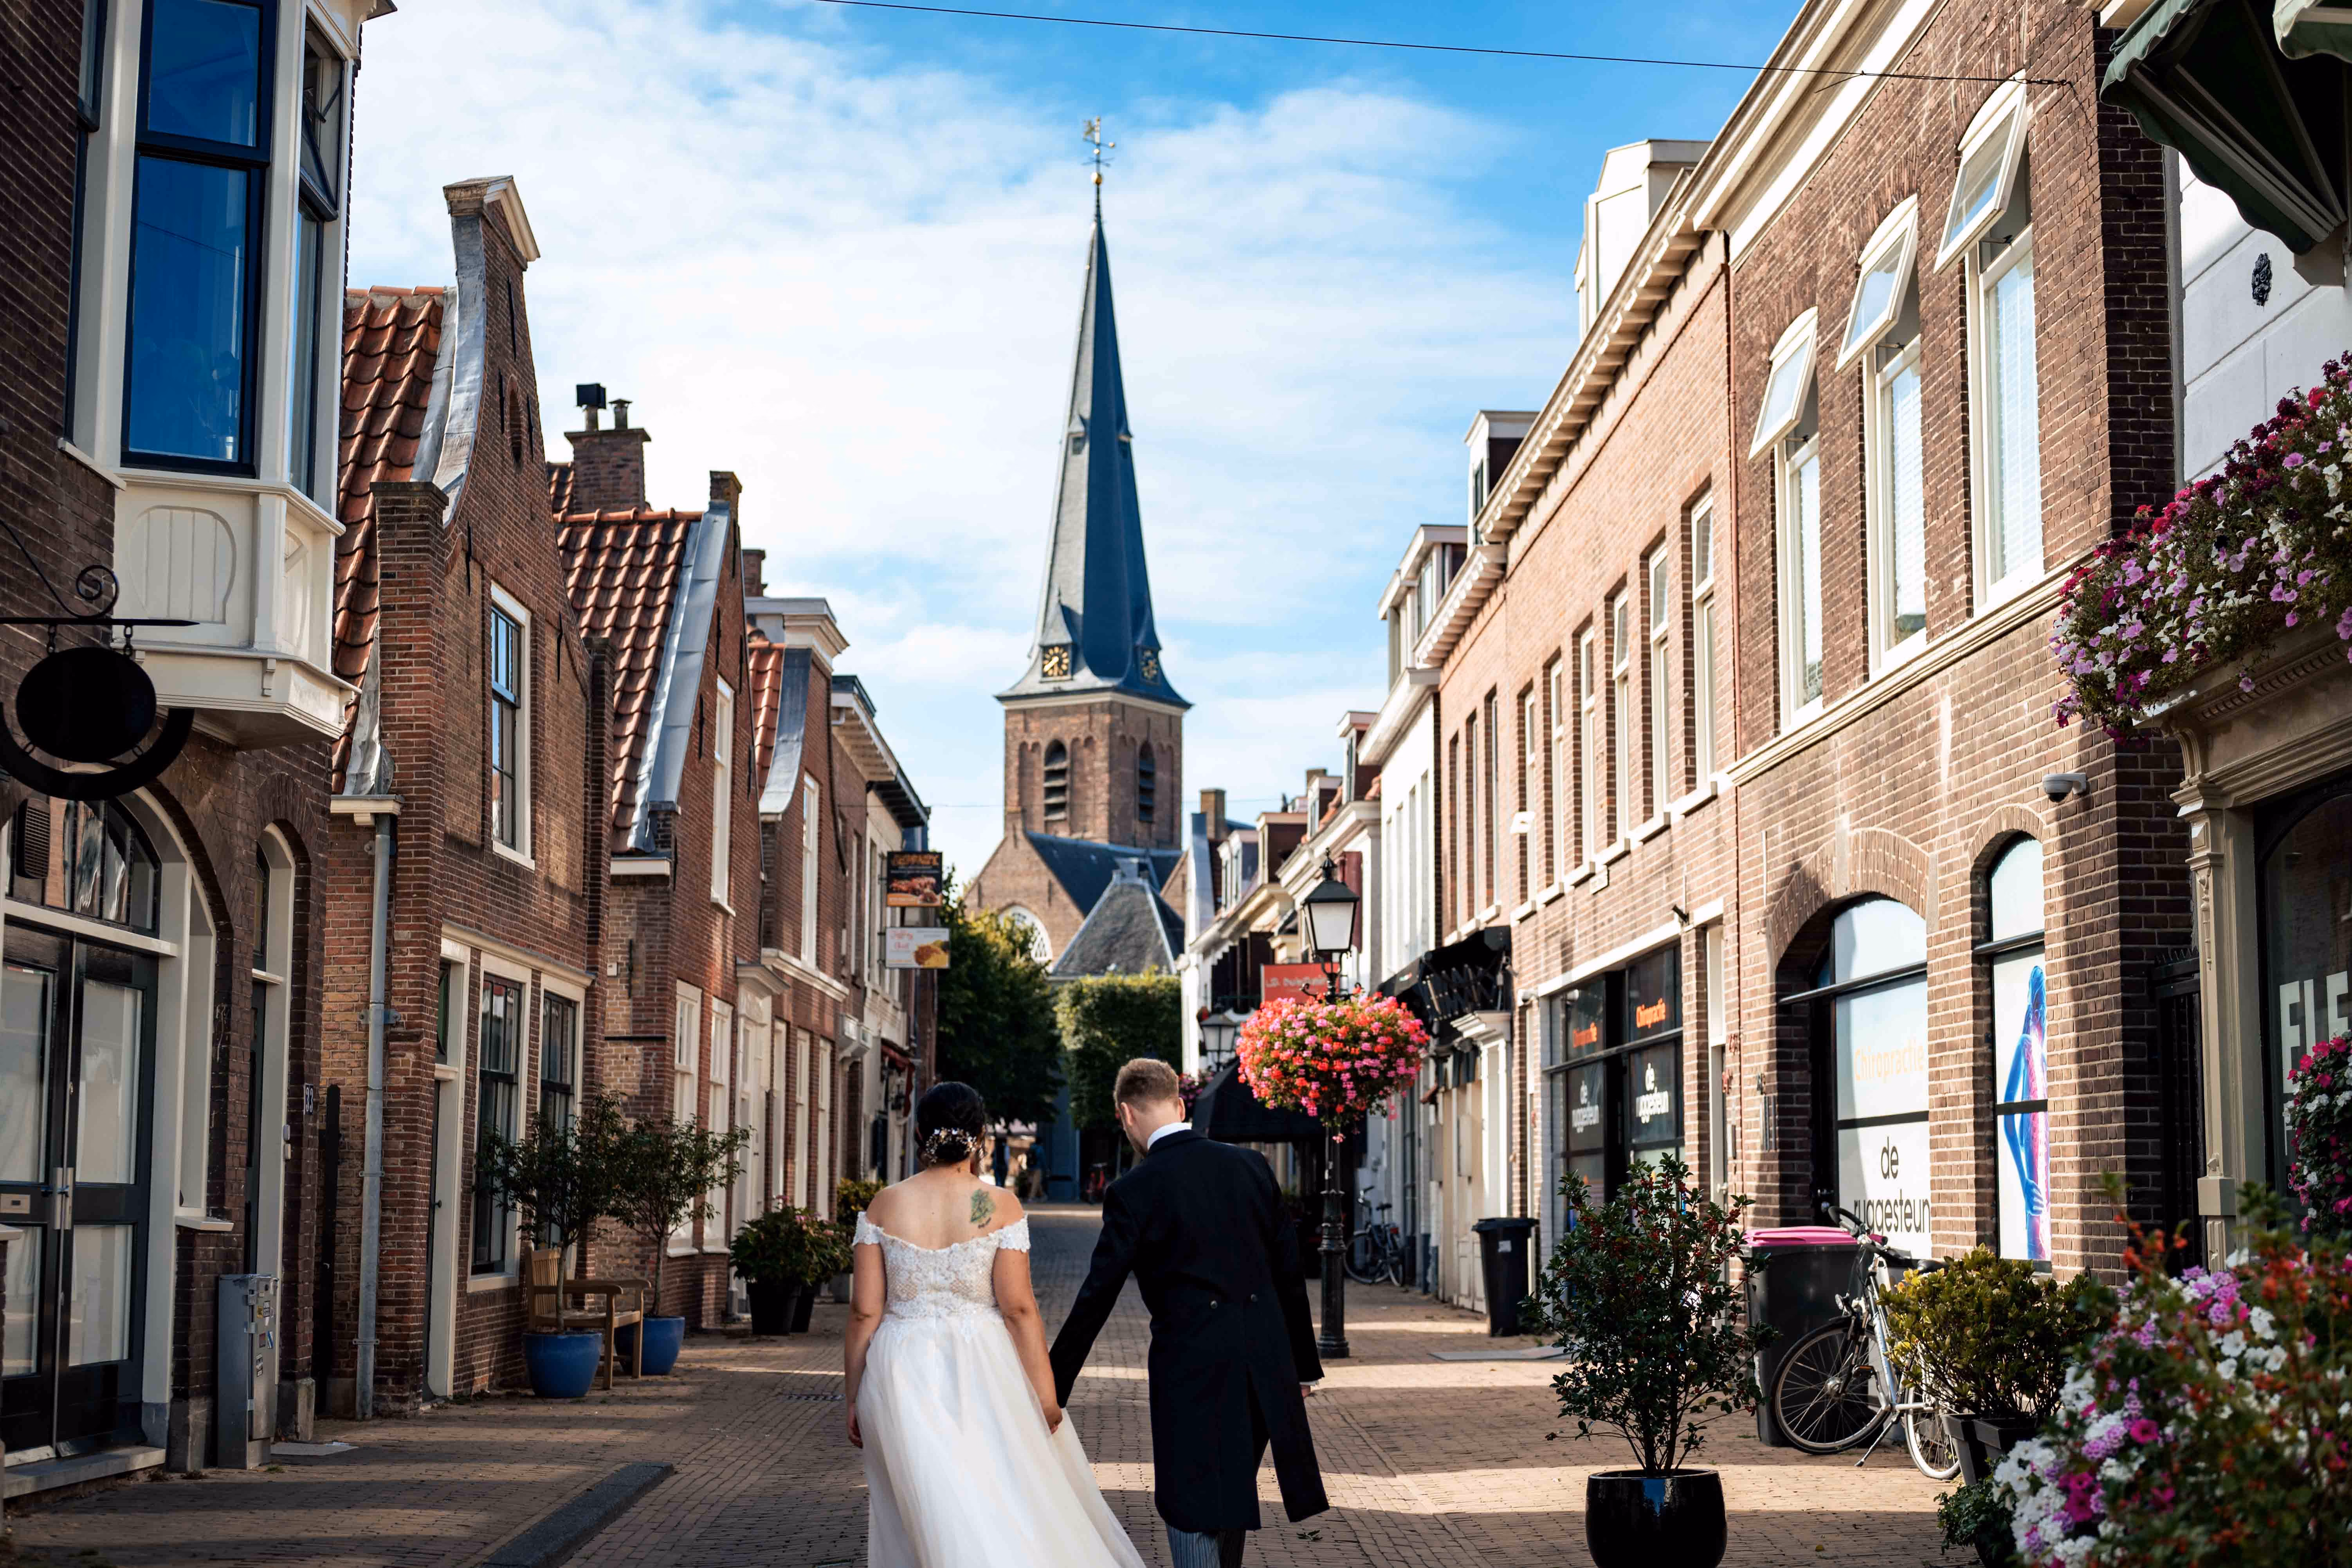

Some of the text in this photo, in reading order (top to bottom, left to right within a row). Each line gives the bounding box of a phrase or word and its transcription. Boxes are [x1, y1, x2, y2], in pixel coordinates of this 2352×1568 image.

[1645, 1063, 1655, 1091] de
[1854, 1040, 1924, 1083] Chiropractie
[306, 1087, 313, 1112] 33
[1881, 1136, 1899, 1179] de
[1854, 1189, 1930, 1236] ruggesteun
